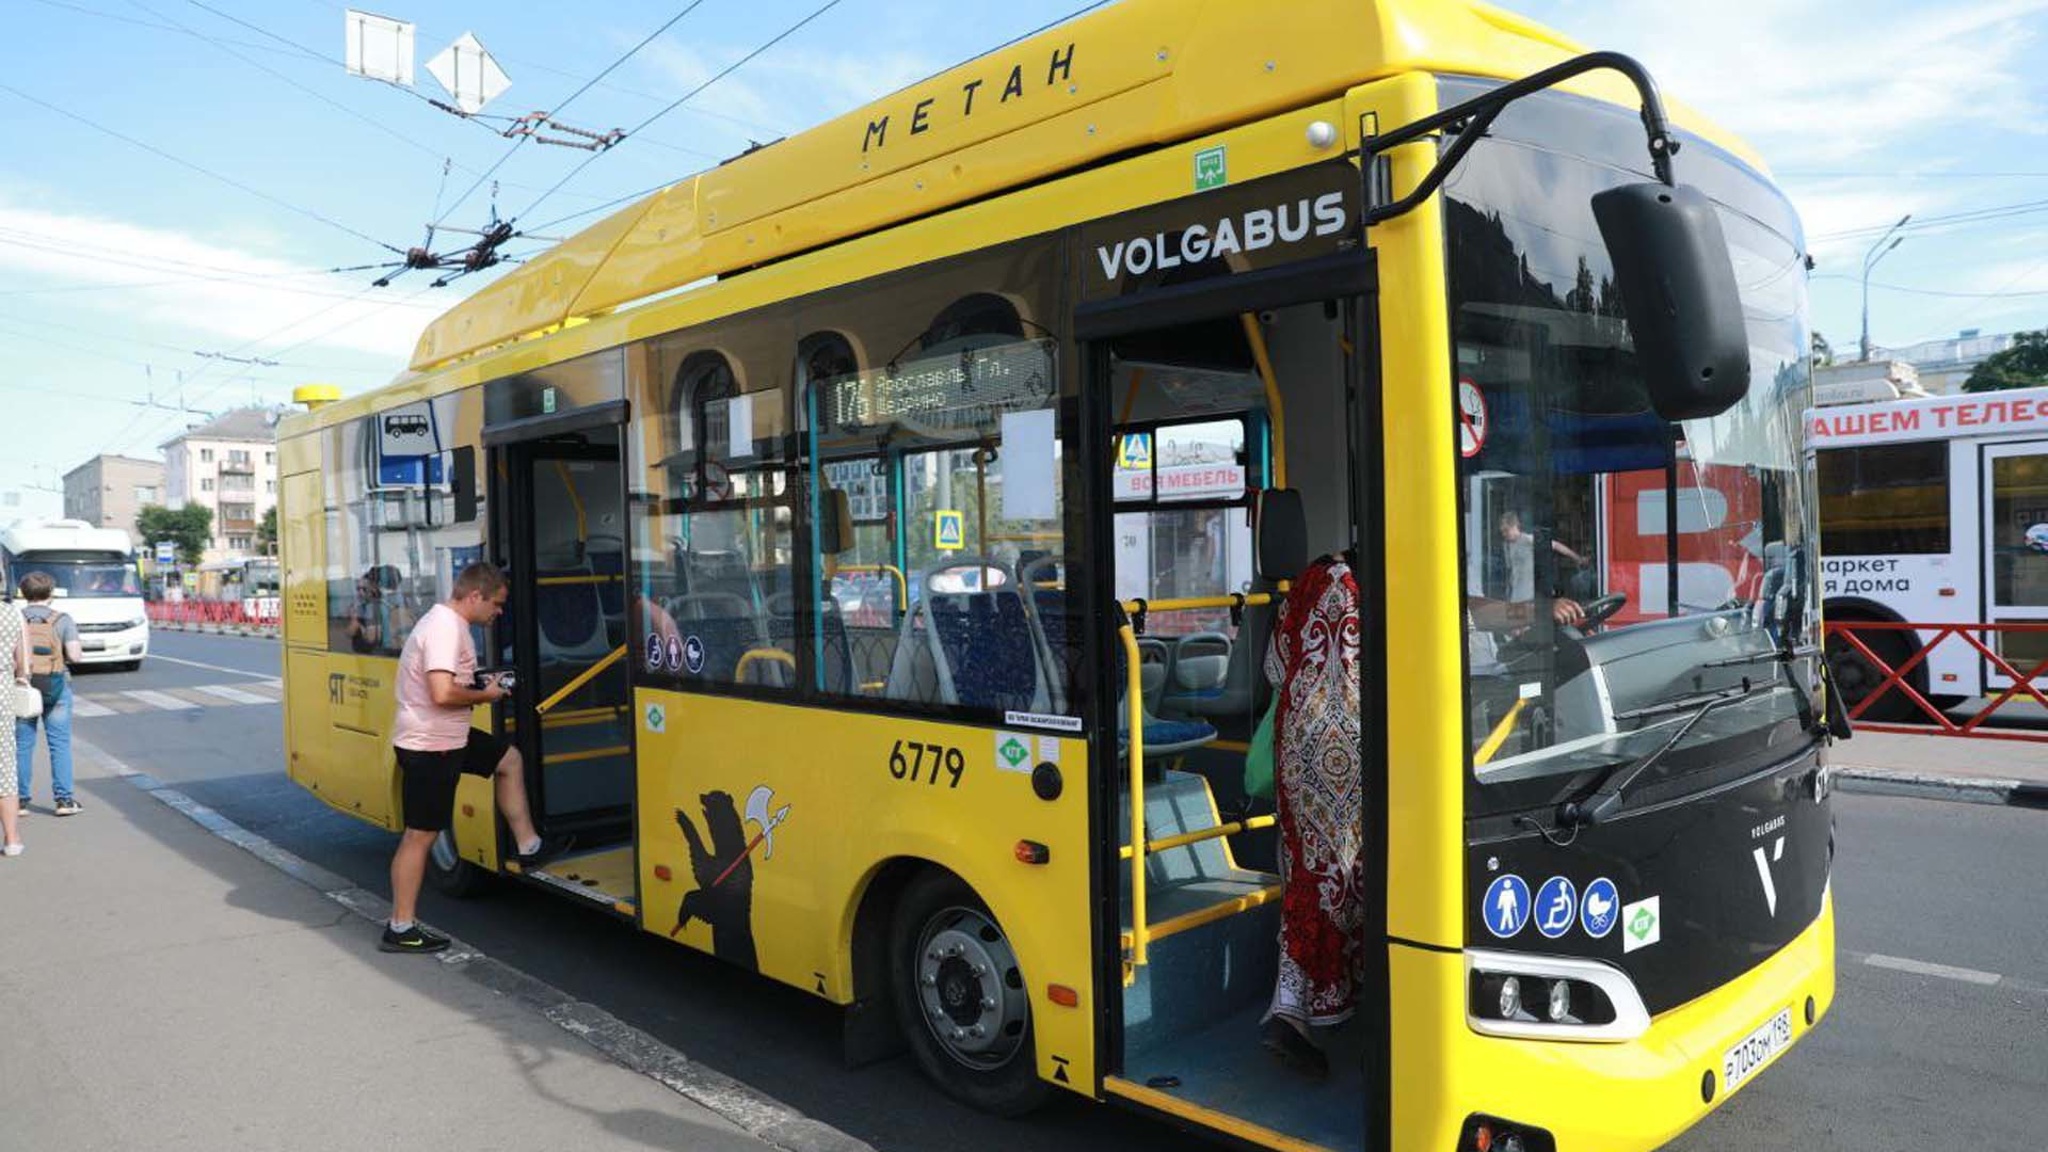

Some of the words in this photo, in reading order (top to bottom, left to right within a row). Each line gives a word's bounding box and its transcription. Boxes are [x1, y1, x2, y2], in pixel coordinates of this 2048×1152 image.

[861, 43, 1075, 152] МЕТАН
[1097, 191, 1347, 281] VOLGABUS
[1168, 469, 1239, 489] МЕБЕЛЬ
[1820, 558, 1899, 576] аркет
[1844, 578, 1910, 595] дома
[889, 739, 965, 788] 6779
[1751, 814, 1786, 840] VOLGABUS
